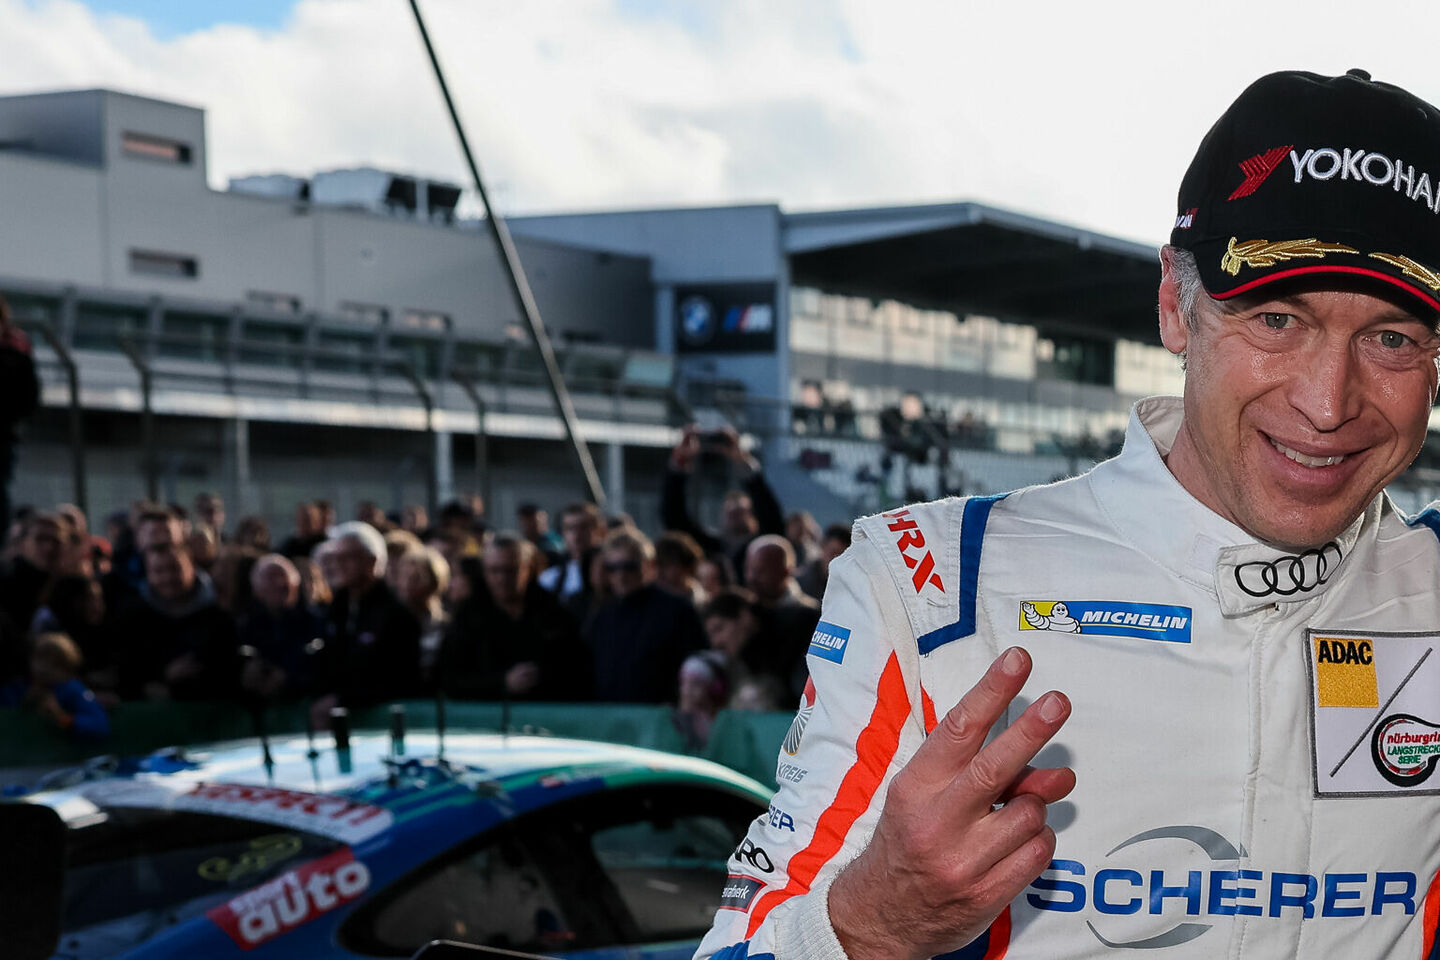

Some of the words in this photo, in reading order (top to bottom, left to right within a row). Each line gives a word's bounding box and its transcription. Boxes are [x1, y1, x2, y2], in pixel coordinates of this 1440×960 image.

[1081, 611, 1188, 629] MICHELIN
[1318, 640, 1373, 665] ADAC
[238, 861, 371, 943] auto
[1027, 859, 1418, 921] SCHERER
